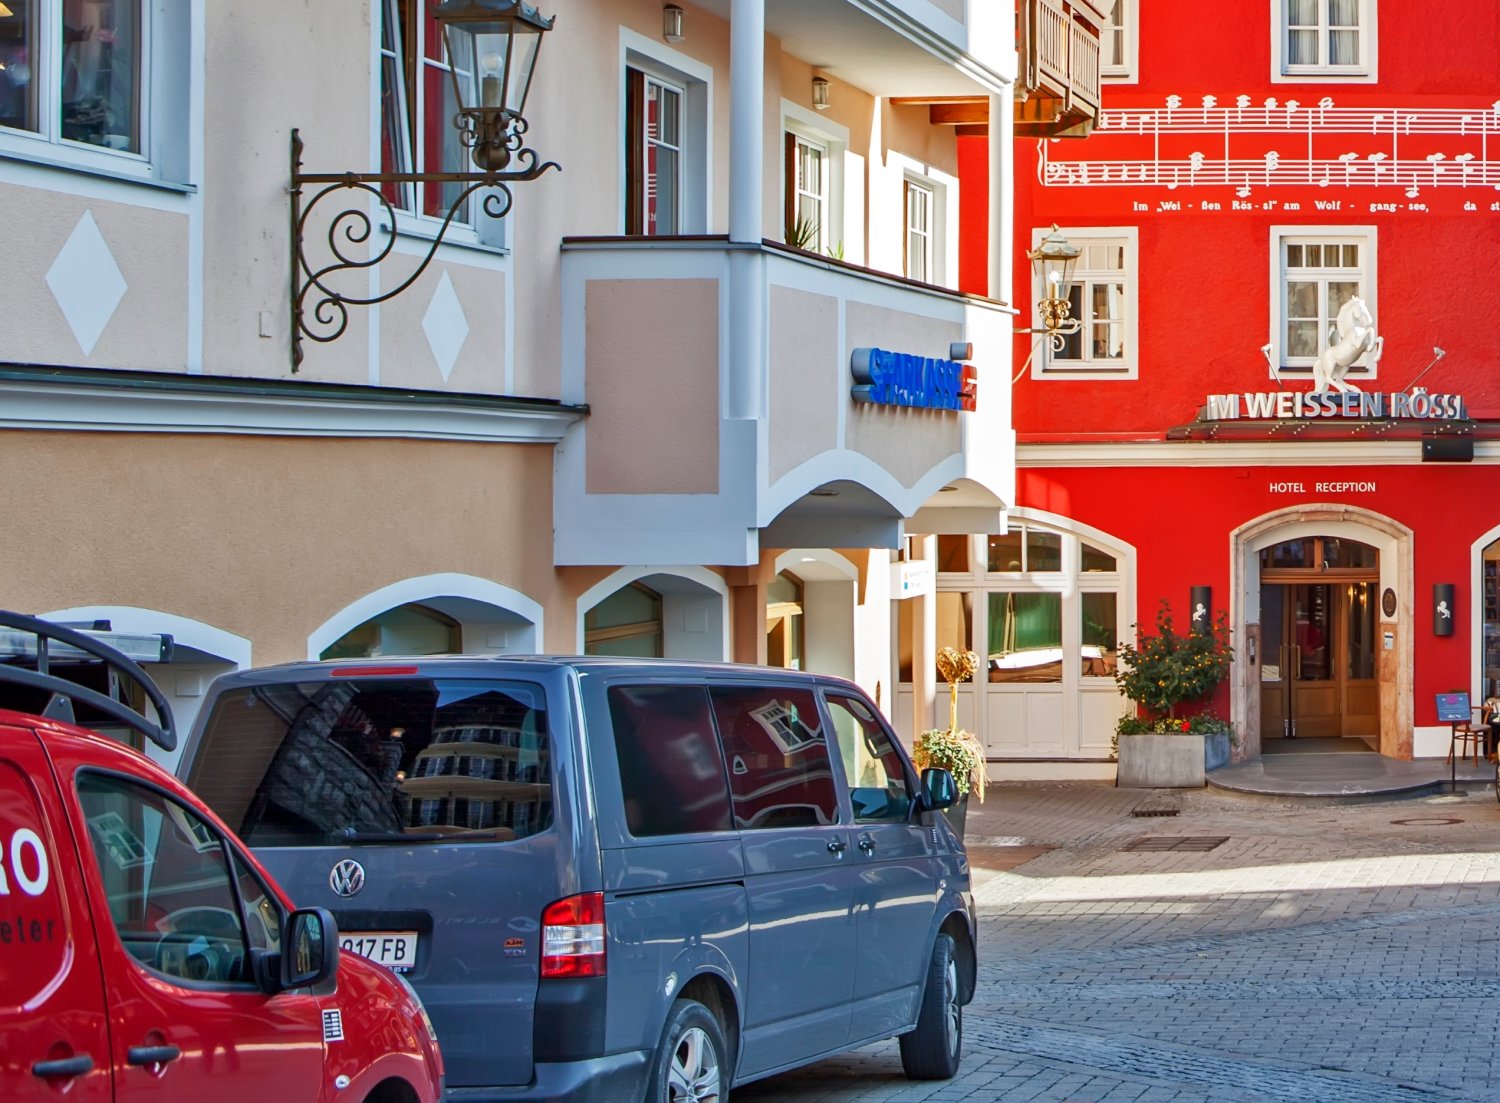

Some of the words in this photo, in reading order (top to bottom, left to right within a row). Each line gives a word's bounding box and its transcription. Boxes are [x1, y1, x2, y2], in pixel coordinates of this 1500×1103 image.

[1133, 201, 1149, 212] Im
[1283, 202, 1301, 211] am
[1463, 200, 1477, 211] da
[1244, 391, 1383, 418] WEISSEN
[1269, 482, 1306, 493] HOTEL
[1315, 481, 1376, 493] RECEPTION
[381, 938, 406, 962] FB
